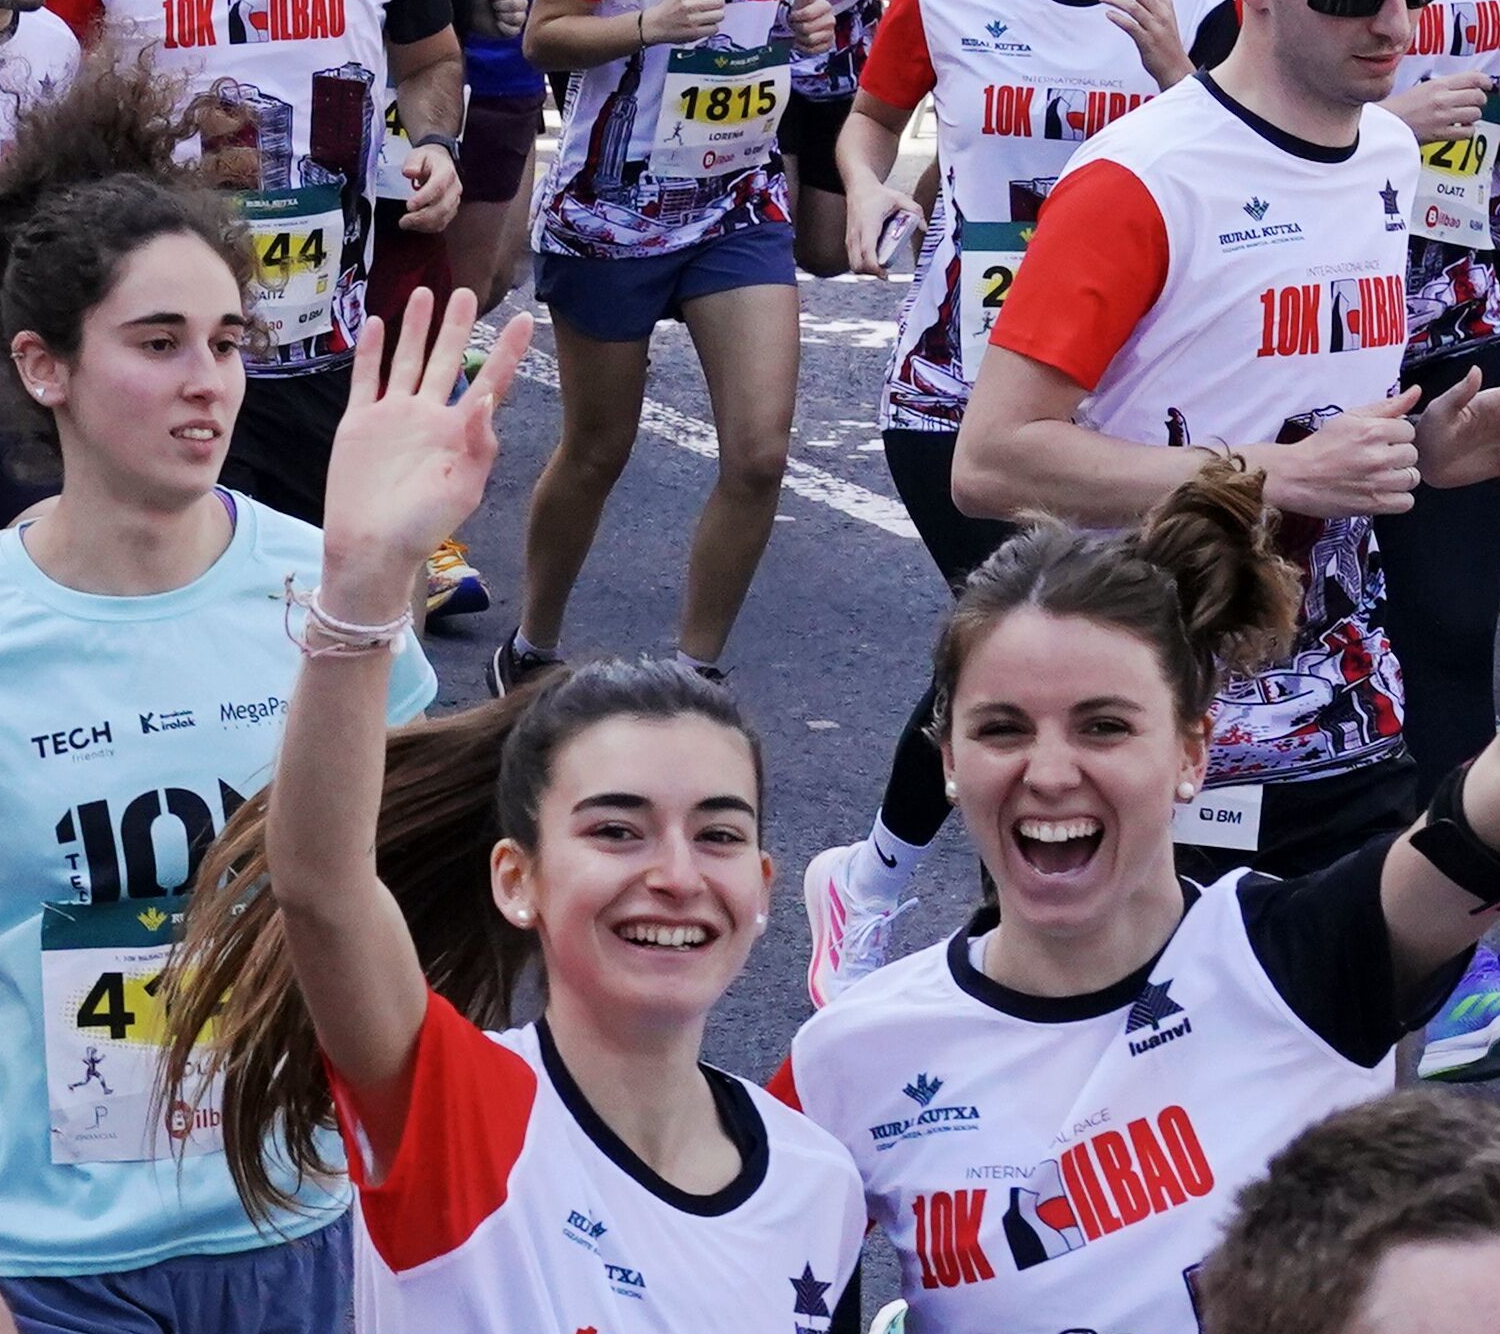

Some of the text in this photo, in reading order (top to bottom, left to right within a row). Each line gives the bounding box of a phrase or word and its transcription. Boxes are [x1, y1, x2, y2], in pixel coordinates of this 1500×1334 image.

[680, 80, 777, 120] 1815
[981, 85, 1035, 138] 10K
[1420, 134, 1488, 176] 279
[1436, 183, 1465, 198] OLATZ
[1218, 222, 1303, 246] RURAL KUTXA
[1257, 288, 1322, 359] 10K
[30, 720, 113, 759] TECH
